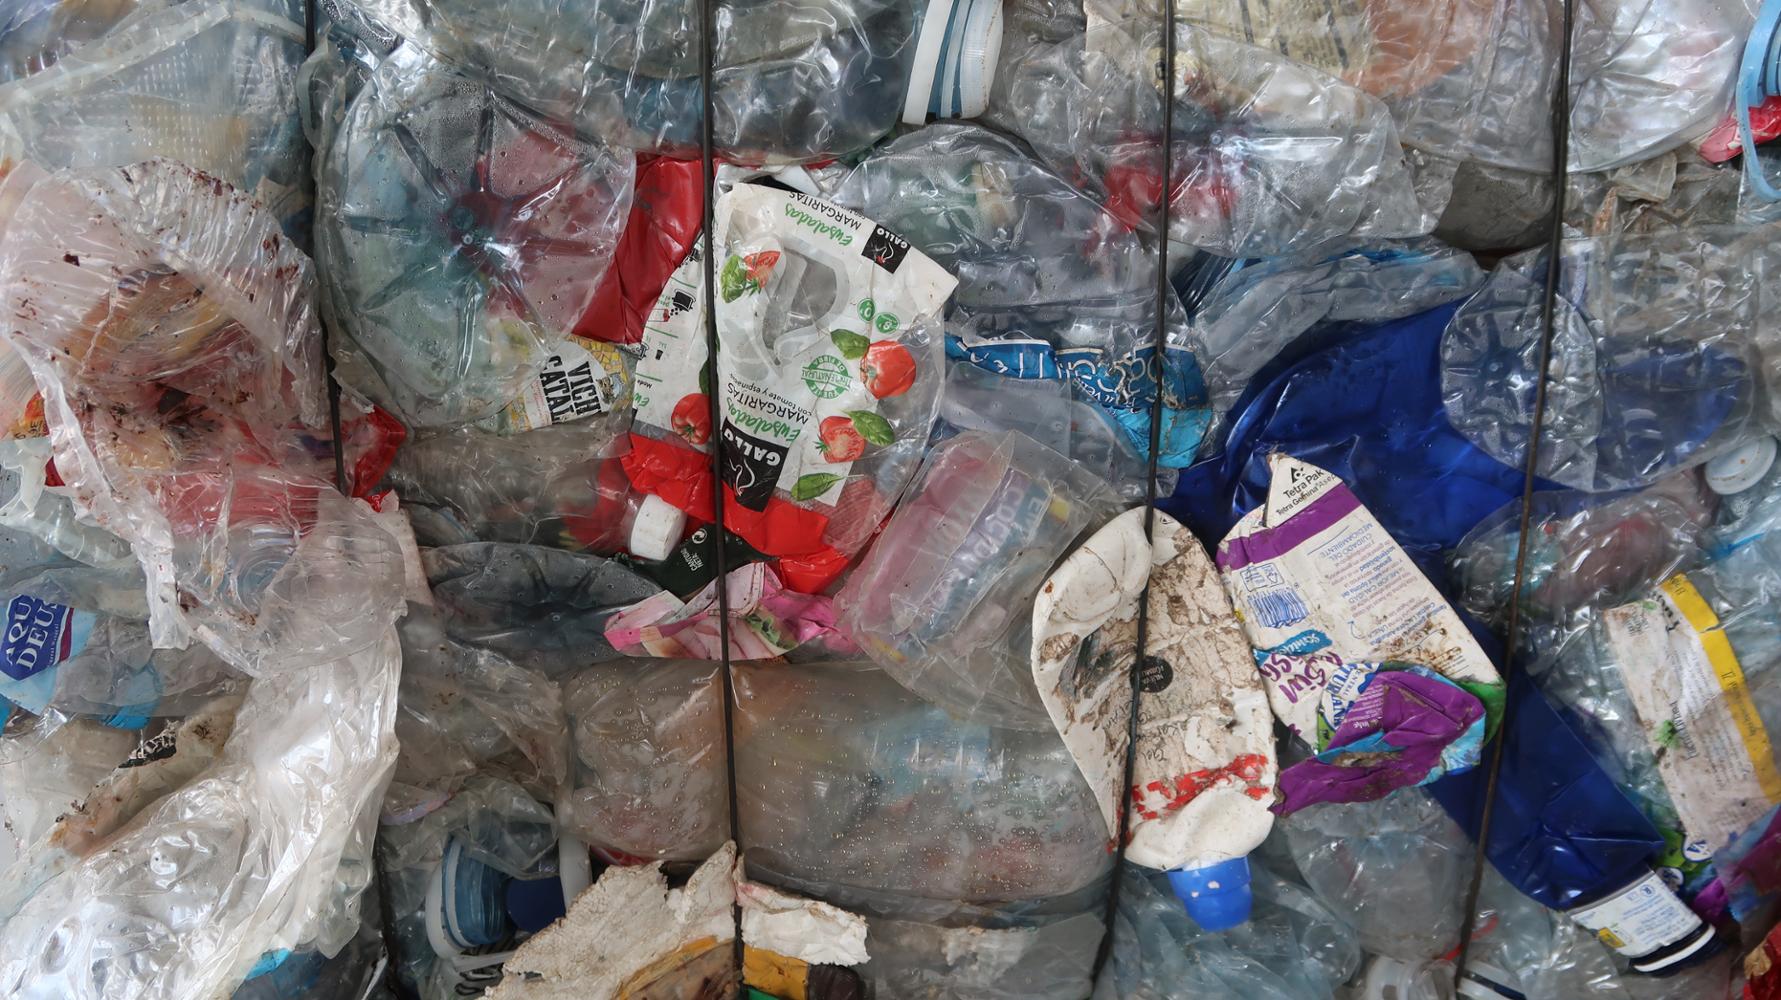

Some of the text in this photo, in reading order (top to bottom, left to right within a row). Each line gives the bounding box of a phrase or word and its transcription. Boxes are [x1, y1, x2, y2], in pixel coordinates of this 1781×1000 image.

[784, 203, 853, 246] Ensaladas
[789, 191, 861, 231] MARGARITAS
[876, 227, 908, 250] GALLO
[540, 355, 574, 424] CATAL
[568, 361, 602, 416] VICH
[727, 382, 809, 425] MARGARITAS
[762, 388, 770, 397] y
[768, 391, 797, 411] tomate
[727, 397, 801, 441] Ensaladas
[723, 428, 781, 466] GALLO
[1283, 470, 1324, 499] Tetra Pak
[1276, 503, 1294, 516] Tetra
[6, 600, 34, 666] AQU
